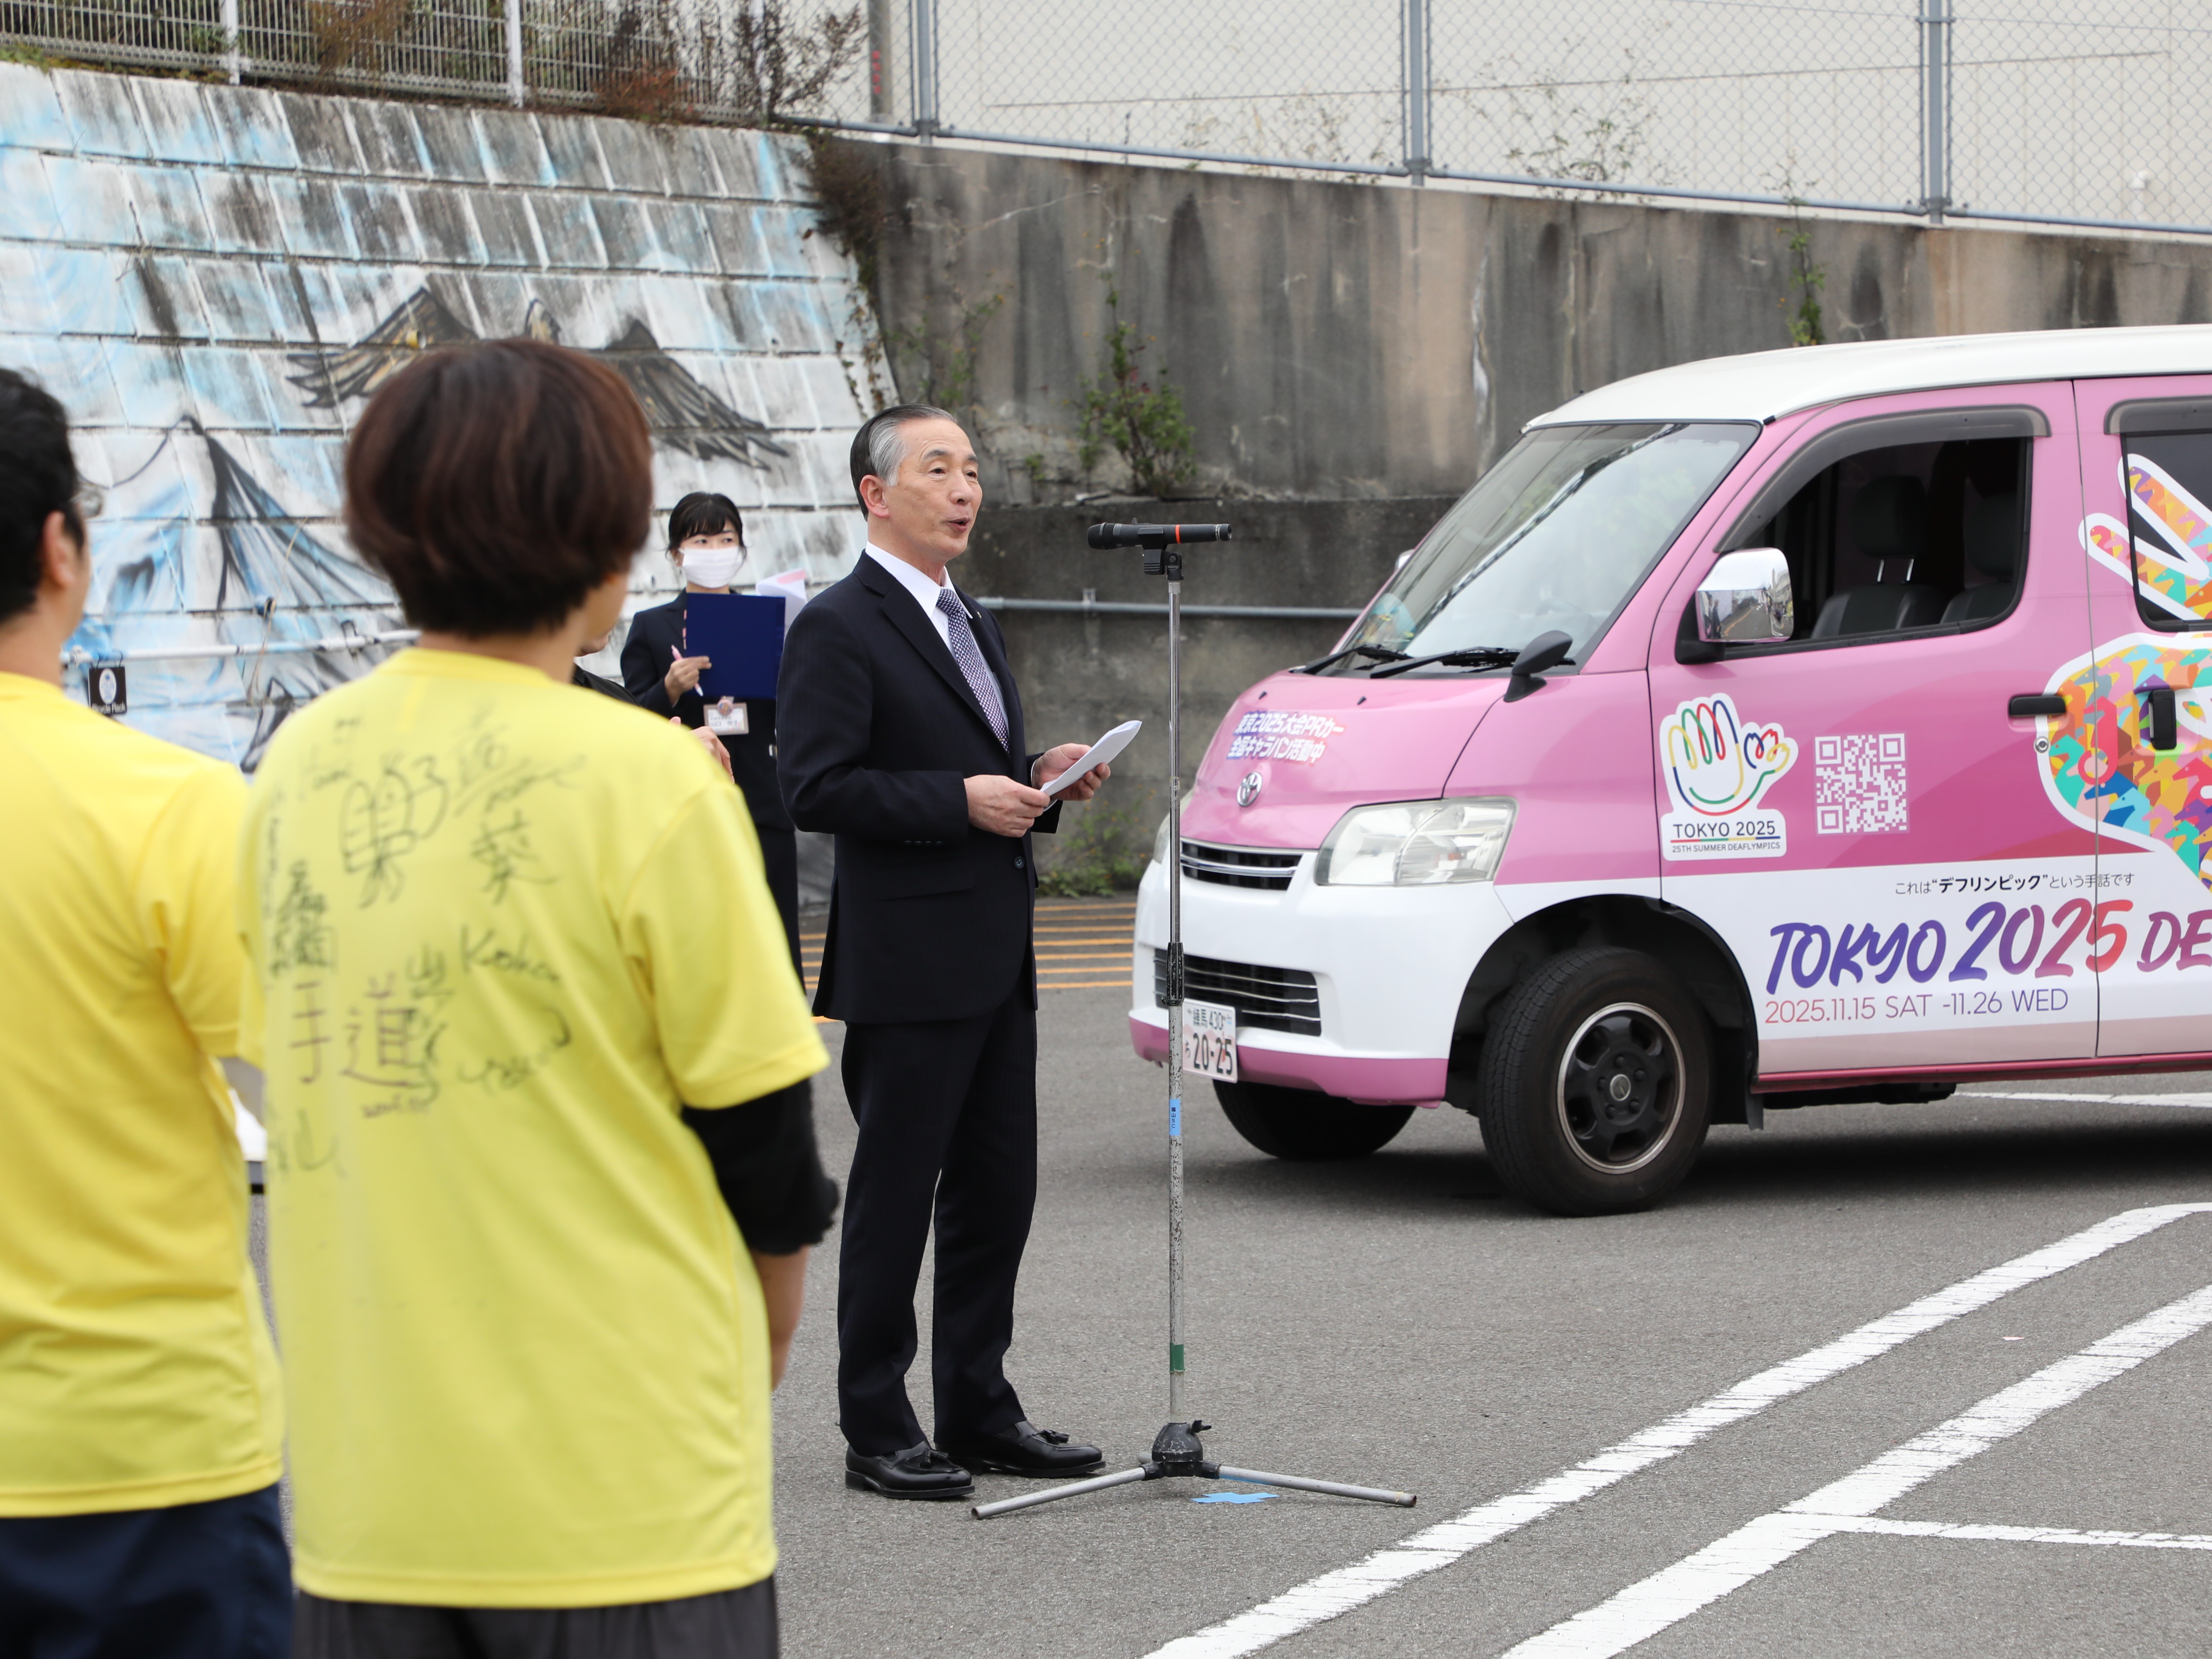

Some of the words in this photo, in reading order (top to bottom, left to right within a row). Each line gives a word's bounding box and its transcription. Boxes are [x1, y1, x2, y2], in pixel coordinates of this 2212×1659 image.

[1234, 712, 1345, 738] 東京2025大会PRカー
[1227, 735, 1327, 764] 全国キャラバン活動中
[1673, 822, 1730, 838] TOKYO
[1736, 821, 1775, 836] 2025
[1693, 844, 1726, 852] SUMMER
[1728, 842, 1780, 851] DEAFLYMPICS
[1766, 920, 1946, 995] TOKYO
[1949, 898, 2133, 982] 2025
[2136, 909, 2212, 972] DE
[1765, 997, 1875, 1024] 2025.11.15
[1885, 994, 1932, 1018] SAT
[1943, 991, 2003, 1015] -11.26
[2011, 989, 2068, 1013] WED
[1209, 1011, 1223, 1030] 430
[1193, 1033, 1232, 1075] 20-25
